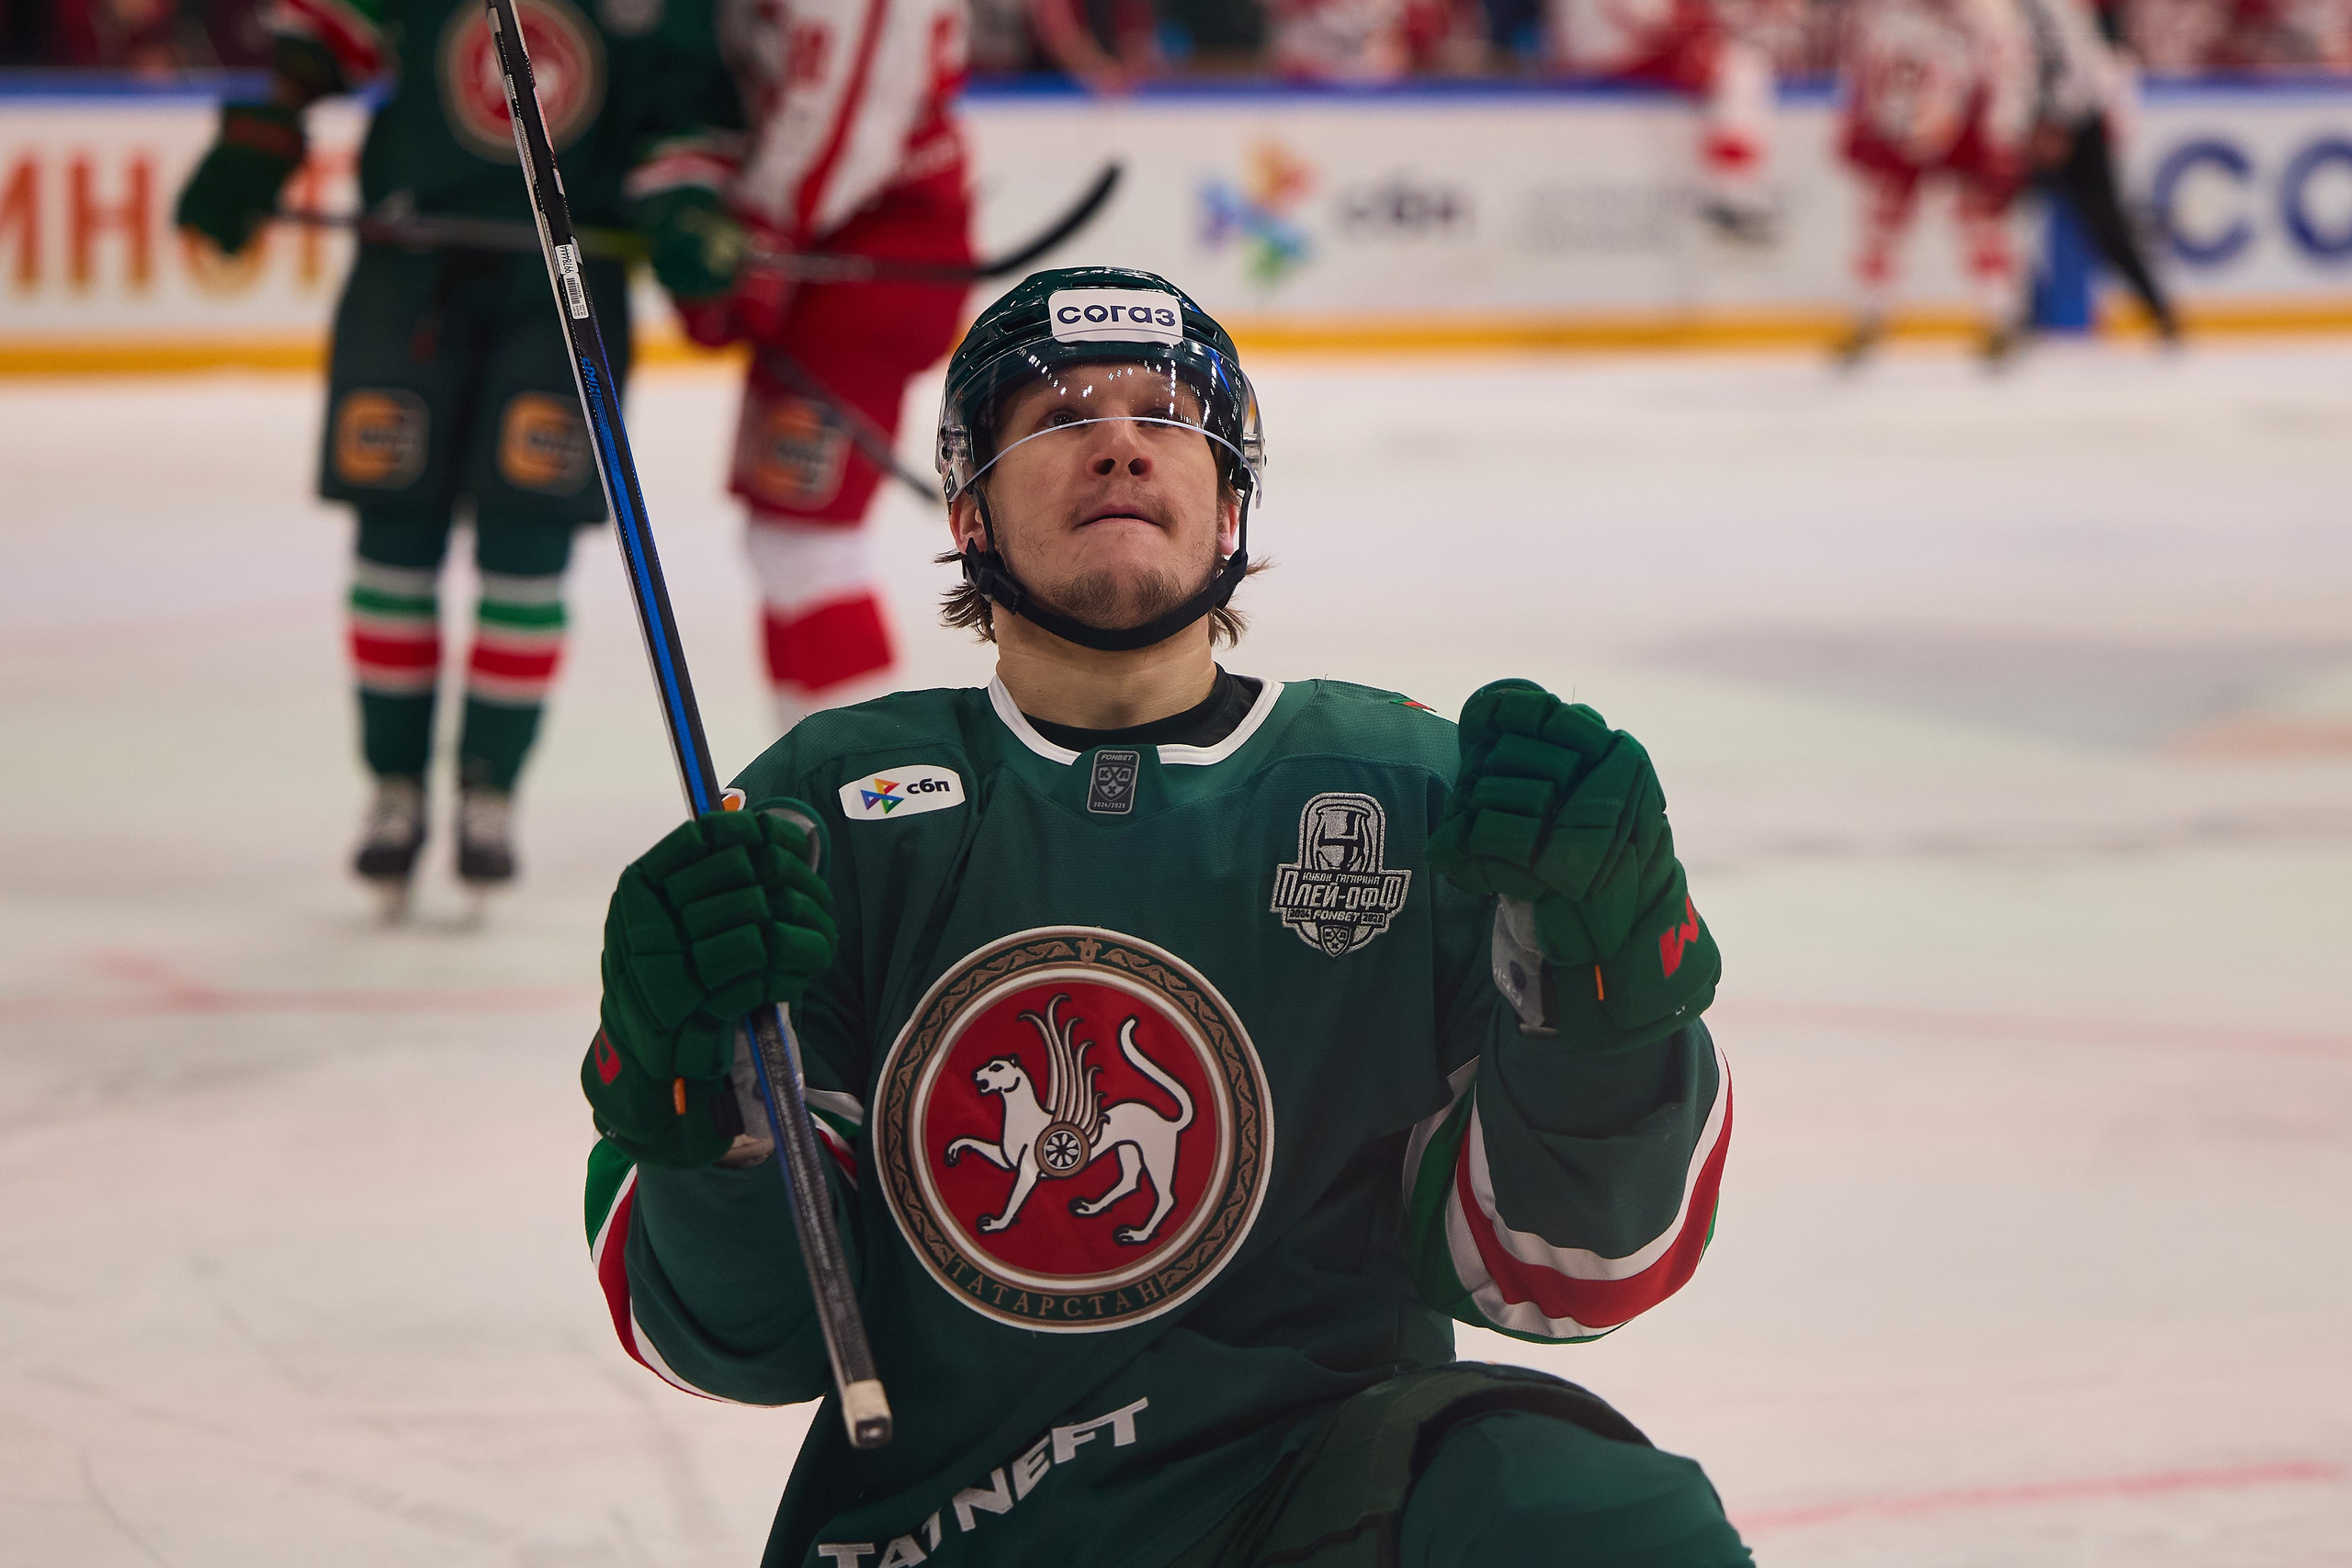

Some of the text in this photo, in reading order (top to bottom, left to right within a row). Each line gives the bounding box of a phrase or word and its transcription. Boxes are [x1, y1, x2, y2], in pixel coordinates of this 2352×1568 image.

[1101, 753, 1134, 761] FONBET
[1092, 801, 1126, 809] 2024/2025
[1335, 874, 1381, 885] ГАГАРИНА
[1278, 870, 1403, 911] ПЛЕЙ-ОФФ
[1313, 909, 1361, 922] FONBET
[950, 1258, 1163, 1317] ТАТАРСТАН
